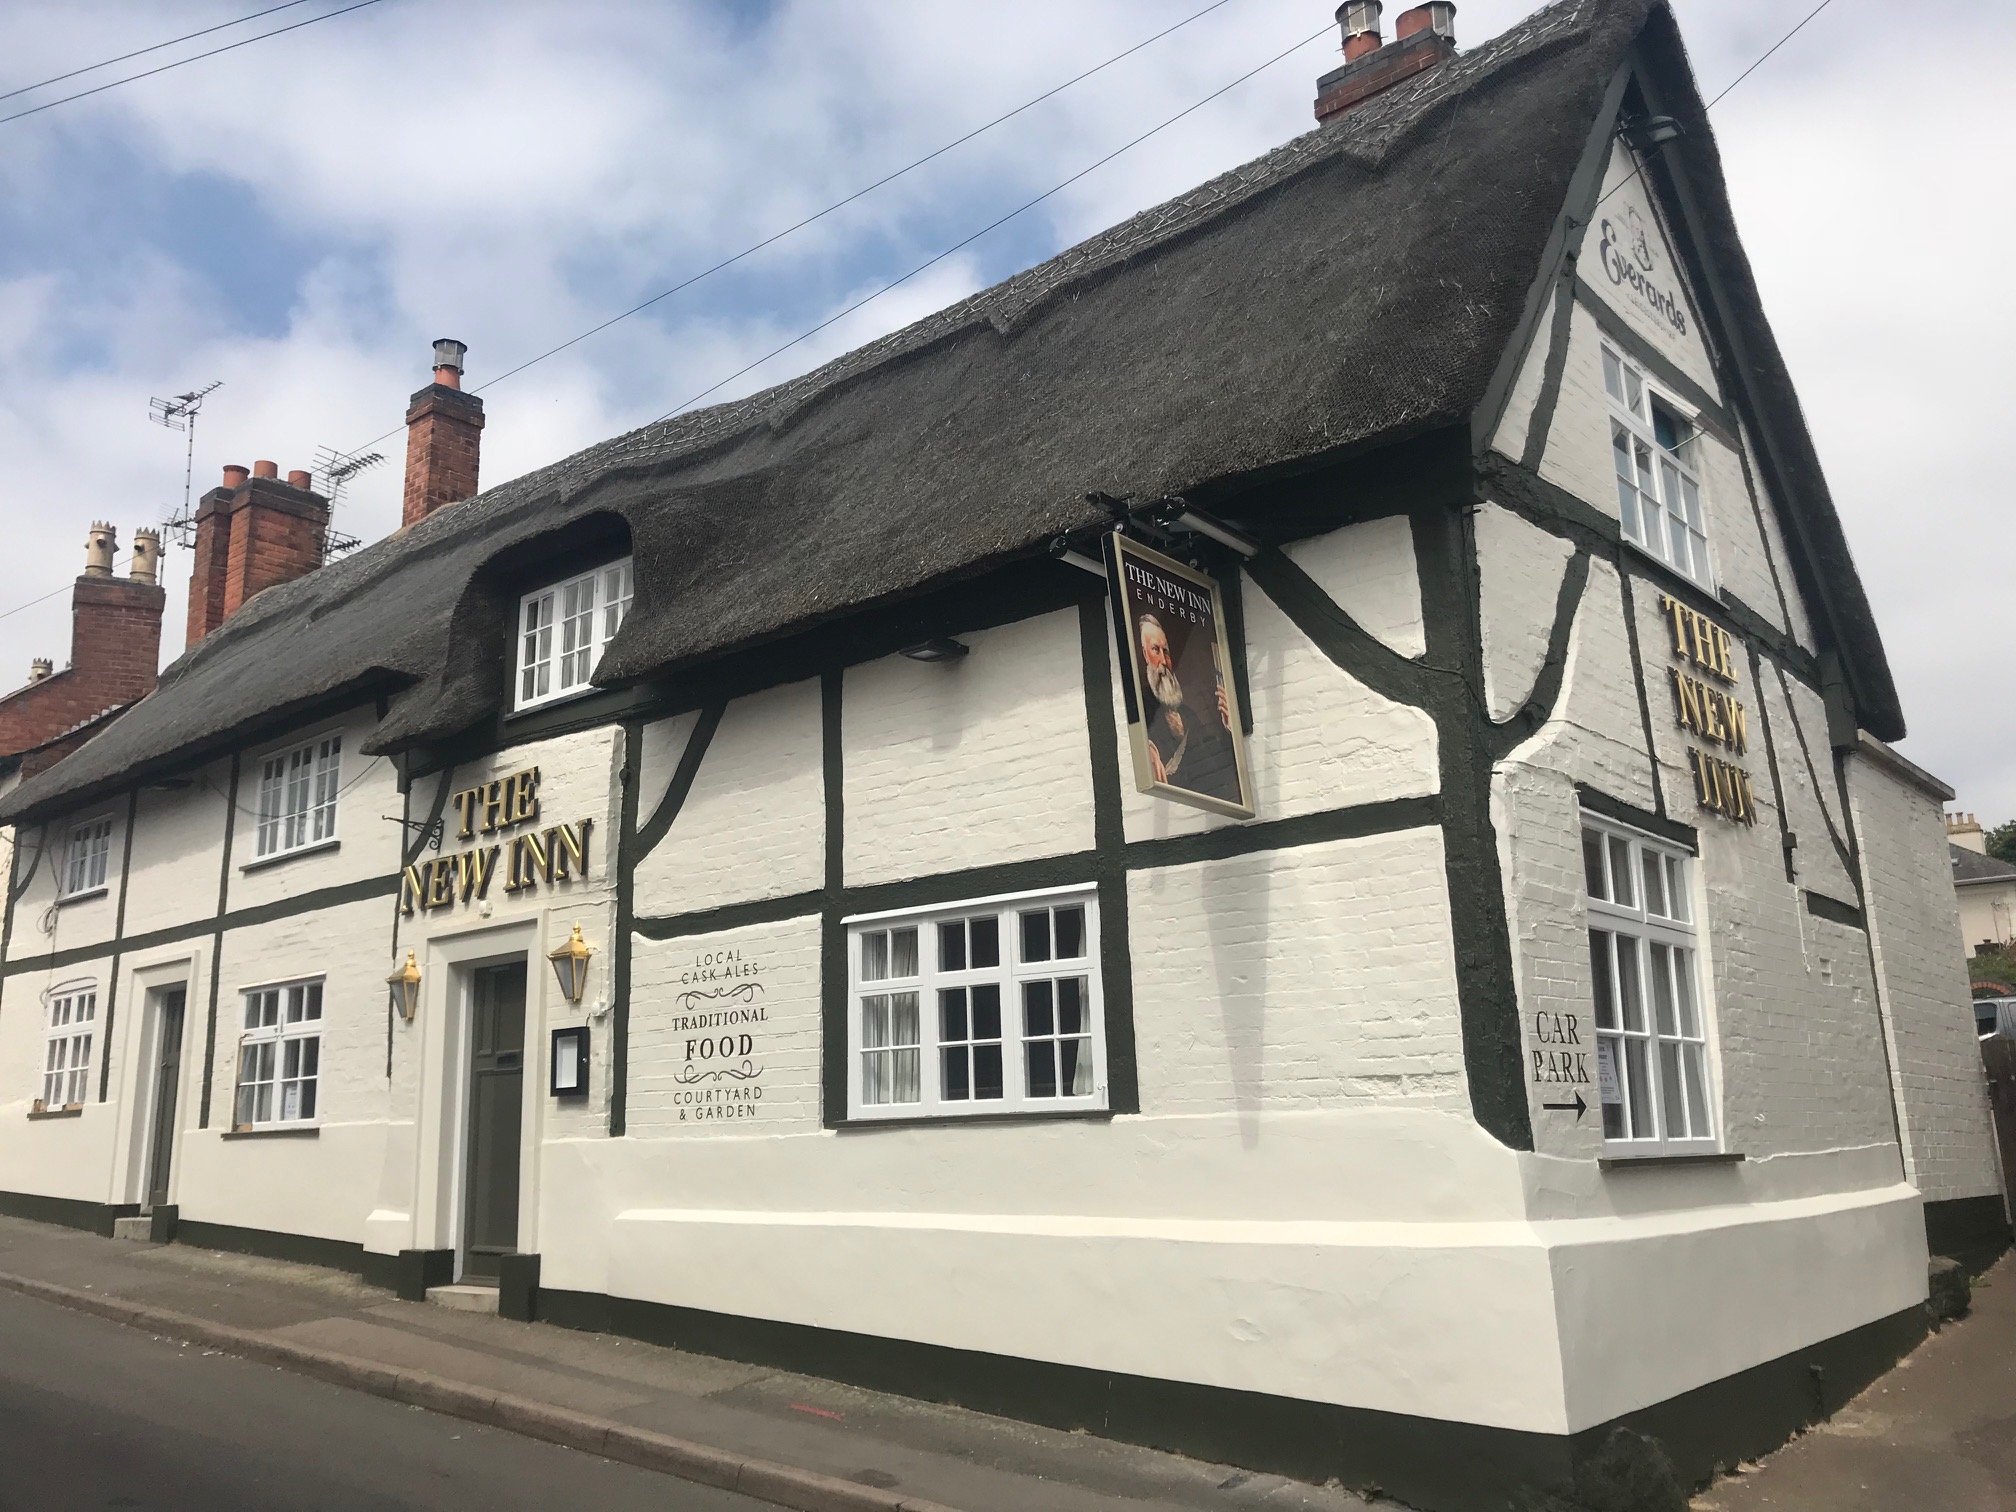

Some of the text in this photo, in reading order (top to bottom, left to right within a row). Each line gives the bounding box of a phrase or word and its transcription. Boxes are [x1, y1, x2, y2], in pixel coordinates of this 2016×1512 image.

[1600, 218, 1687, 336] Everards
[1125, 561, 1211, 615] THE NEW INN
[1136, 588, 1206, 627] ENDERBY
[1661, 594, 1738, 684] THE
[1669, 666, 1747, 756] NEW
[452, 766, 541, 841] THE
[1690, 747, 1757, 827] INN
[400, 817, 593, 915] NEW INN
[681, 962, 759, 985] CASK ALES
[696, 949, 743, 967] LOCAL
[672, 1008, 769, 1031] TRADITIONAL
[1536, 1010, 1581, 1045] CAR
[684, 1033, 753, 1061] FOOD
[1531, 1049, 1591, 1084] PARK
[673, 1086, 762, 1105] COURTYARD
[679, 1104, 756, 1121] & GARDEN
